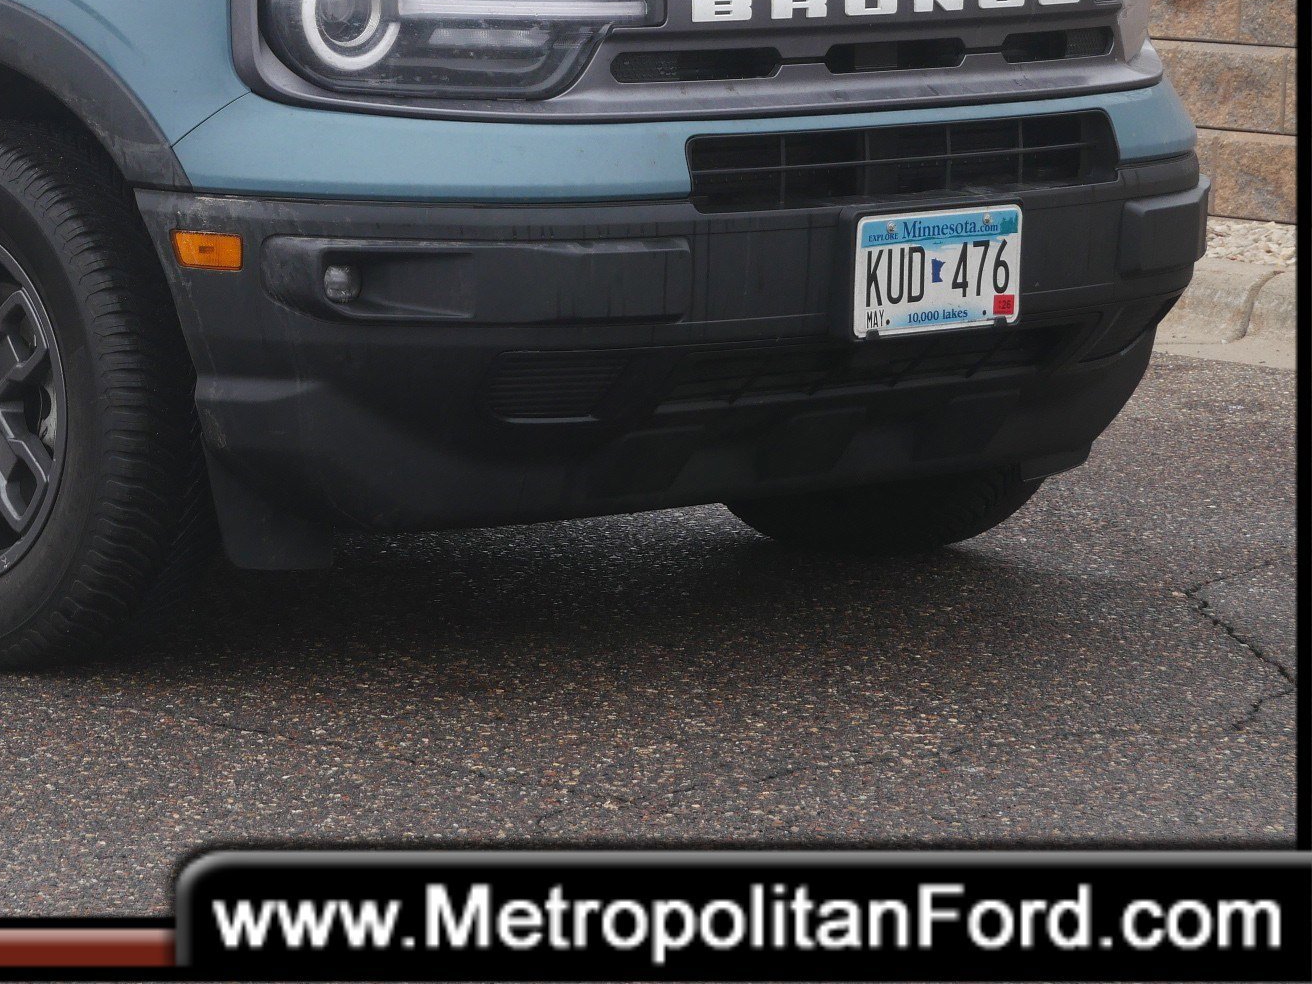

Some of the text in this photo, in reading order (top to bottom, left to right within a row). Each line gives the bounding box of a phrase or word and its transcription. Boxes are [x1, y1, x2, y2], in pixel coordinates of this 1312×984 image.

[868, 233, 899, 243] EXPLORE
[865, 238, 1010, 308] KUD 476
[866, 309, 885, 329] MAY
[907, 307, 969, 324] 10,000 lakes
